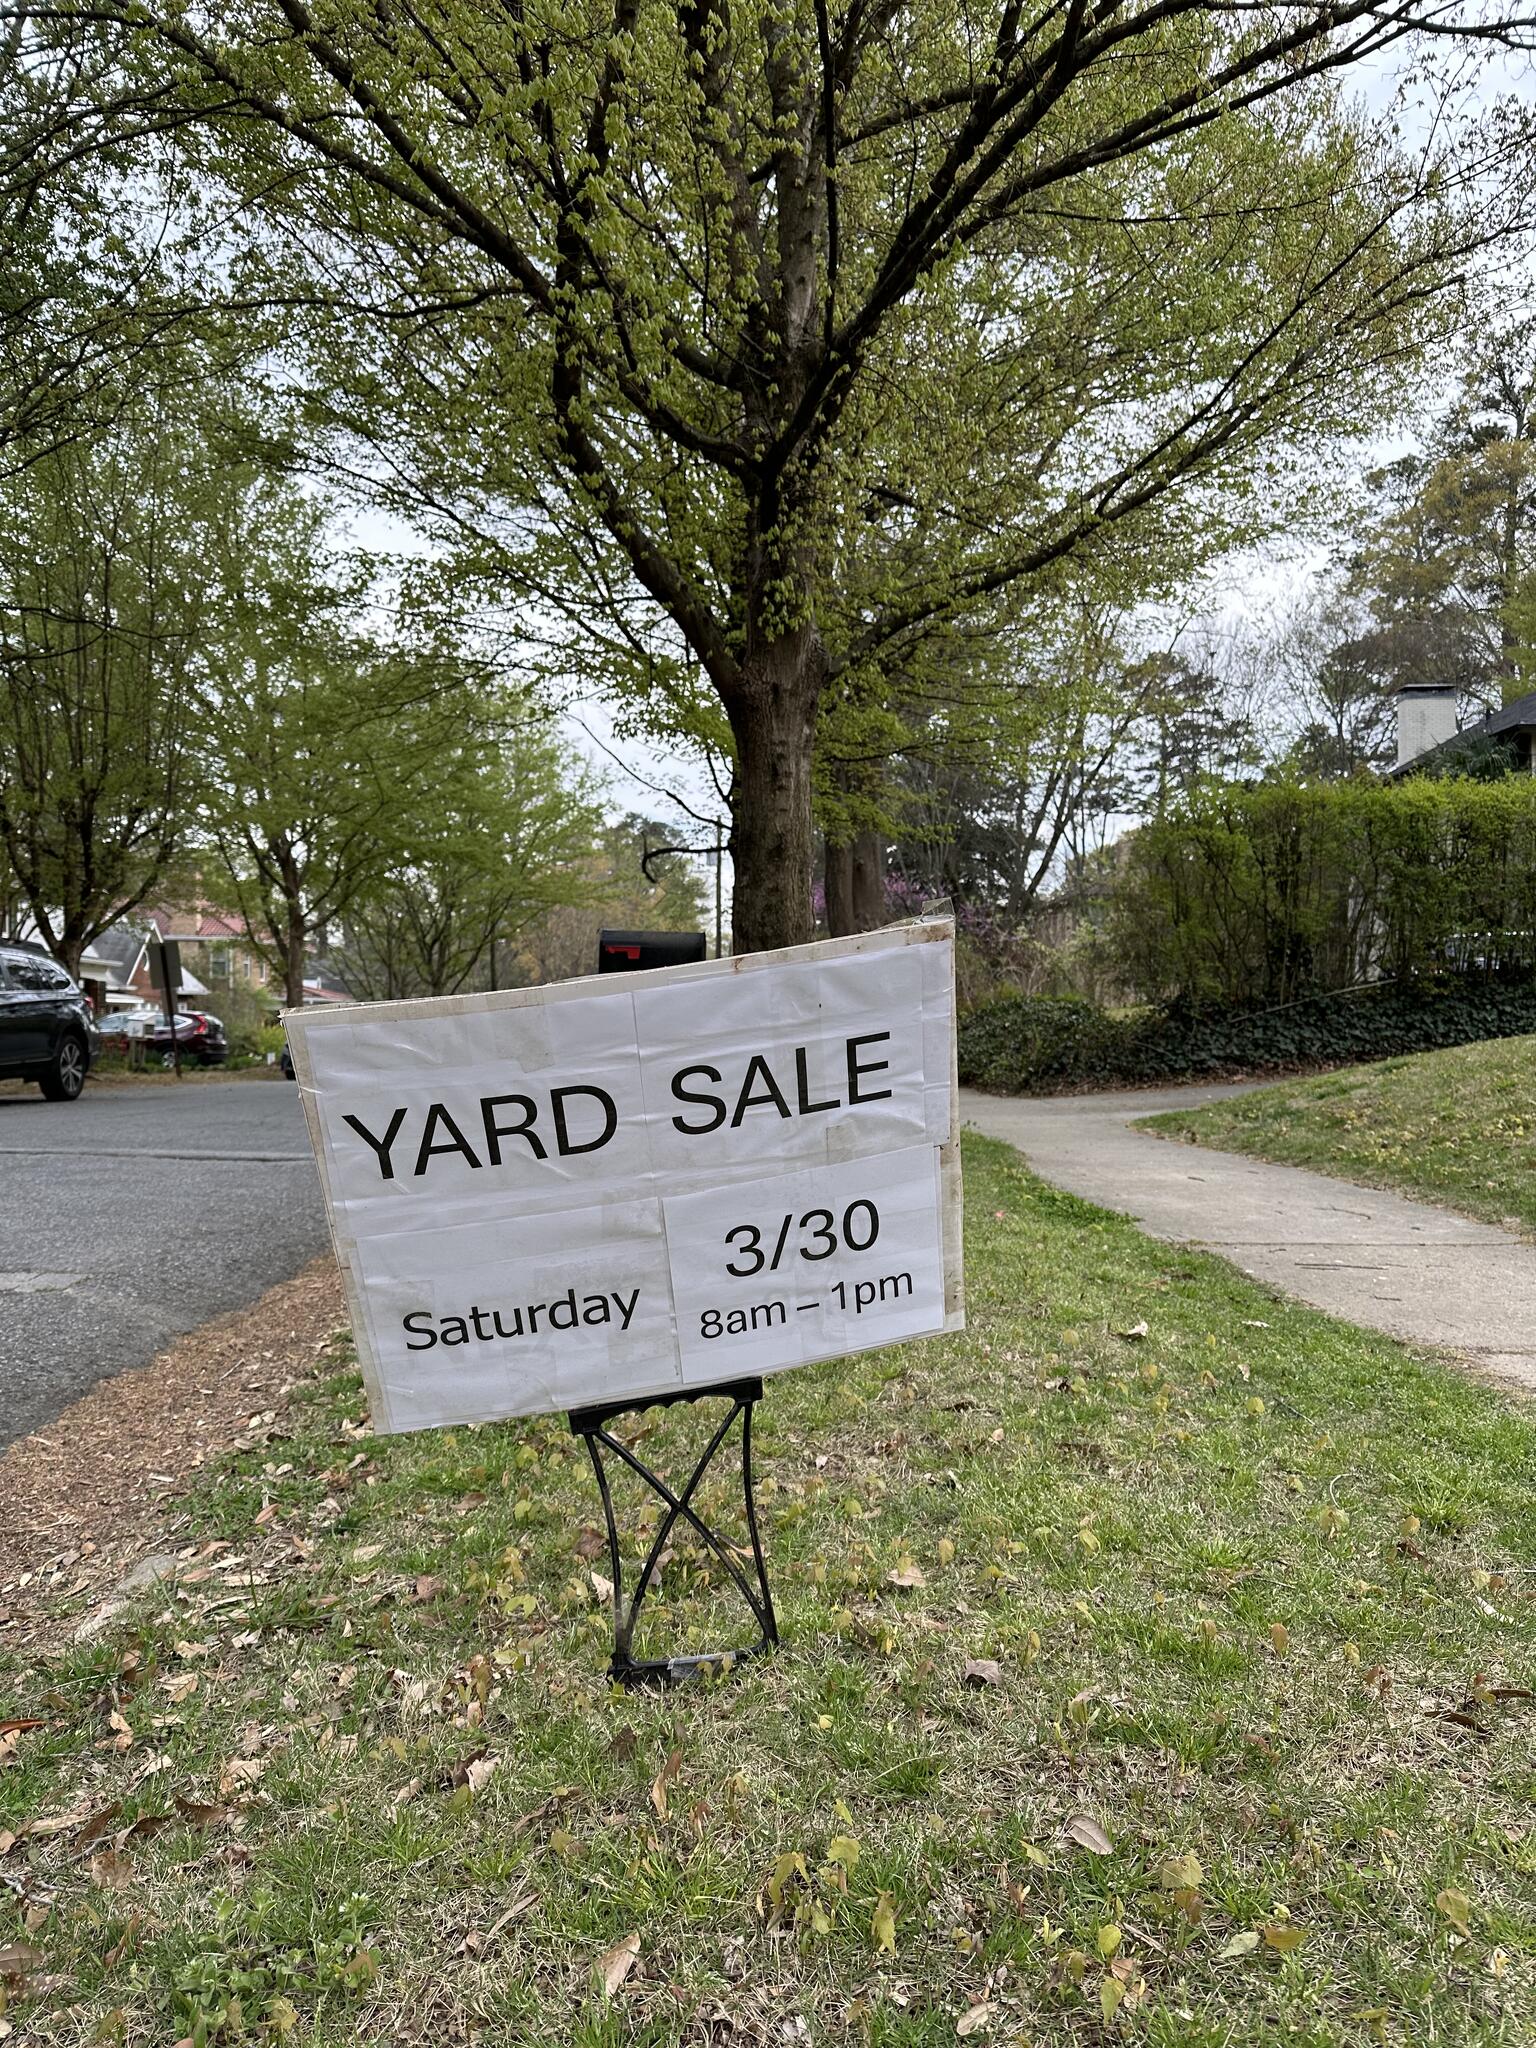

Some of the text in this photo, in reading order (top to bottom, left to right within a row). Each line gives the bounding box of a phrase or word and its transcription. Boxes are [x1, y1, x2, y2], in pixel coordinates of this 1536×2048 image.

[341, 1031, 893, 1180] YARD SALE
[724, 1199, 880, 1278] 3/30
[402, 1288, 641, 1351] Saturday
[700, 1300, 787, 1339] 8am
[831, 1272, 913, 1314] 1pm
